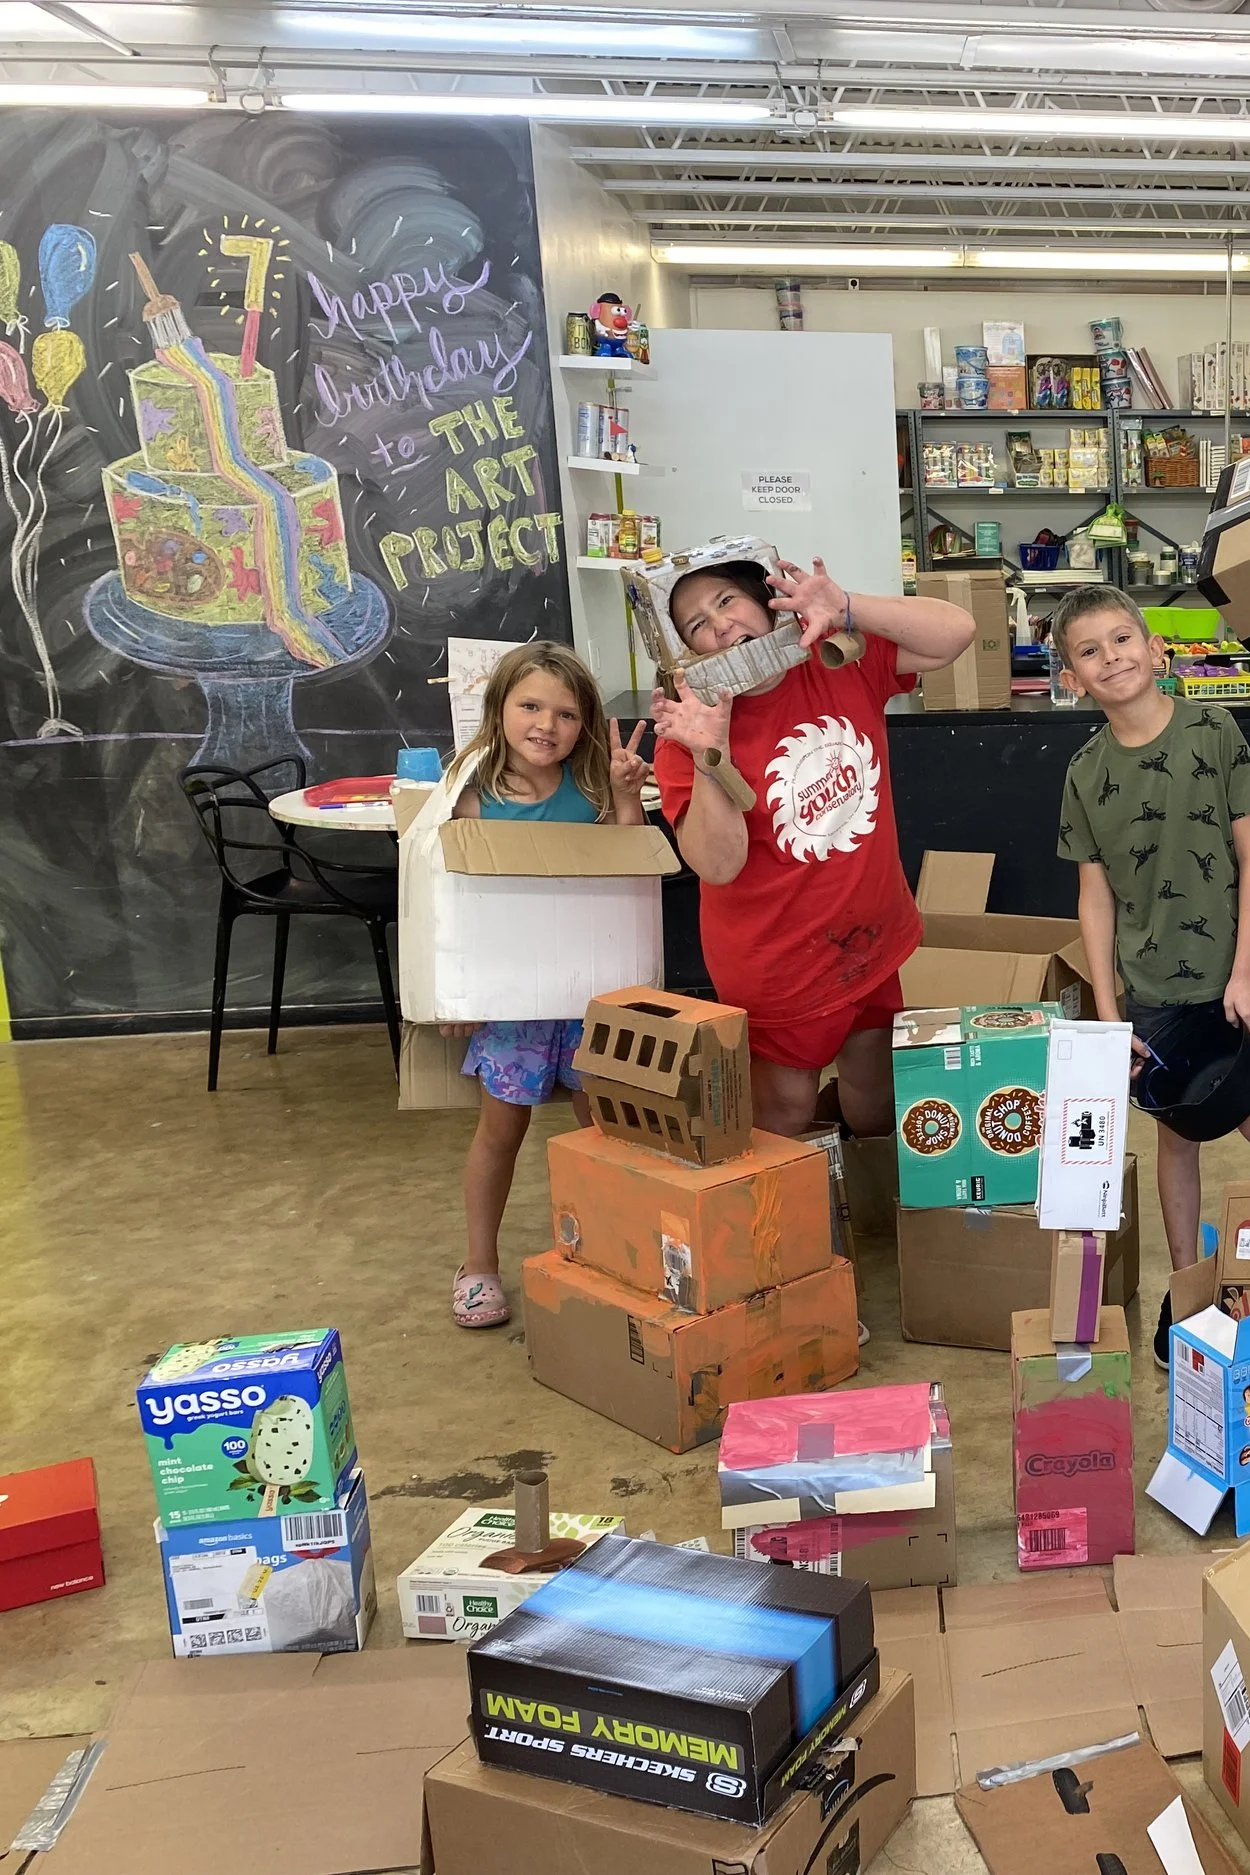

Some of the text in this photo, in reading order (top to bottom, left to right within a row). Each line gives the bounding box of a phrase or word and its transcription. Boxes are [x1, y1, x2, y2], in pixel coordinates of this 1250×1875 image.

[306, 260, 490, 344] happy
[314, 327, 532, 427] birthday
[370, 396, 525, 468] to THE
[446, 444, 537, 513] ART
[775, 486, 801, 494] DOOR
[759, 496, 793, 504] CLOSED
[380, 512, 563, 591] PROJECT
[797, 770, 834, 802] summer
[799, 761, 858, 826] youth
[925, 1109, 950, 1147] DONUT SHOP
[986, 1107, 995, 1139] ORIGINAL
[991, 1099, 1022, 1143] DONUT SHOP
[1021, 1104, 1034, 1136] COFFEE
[1098, 1136, 1105, 1147] UN
[212, 1353, 300, 1373] yasso
[317, 1352, 333, 1384] yasso
[145, 1385, 266, 1425] yasso
[207, 1411, 228, 1420] yogurt
[158, 1457, 182, 1466] mint
[223, 1440, 246, 1451] 100
[160, 1463, 214, 1476] chocolate
[1024, 1450, 1116, 1477] Crayola
[162, 1475, 184, 1485] chip
[169, 1511, 182, 1519] 15
[265, 1489, 275, 1512] yasso
[598, 1516, 615, 1524] 18
[199, 1533, 253, 1545] amazon basics
[50, 1575, 94, 1590] new balance
[466, 1605, 494, 1613] Choice
[469, 1600, 493, 1609] Healthy
[486, 1692, 581, 1734] FOAM
[809, 1703, 848, 1755] MEMORY
[591, 1716, 739, 1770] MEMORY
[570, 1744, 697, 1783] SKECHERS
[780, 1753, 808, 1788] FOAM
